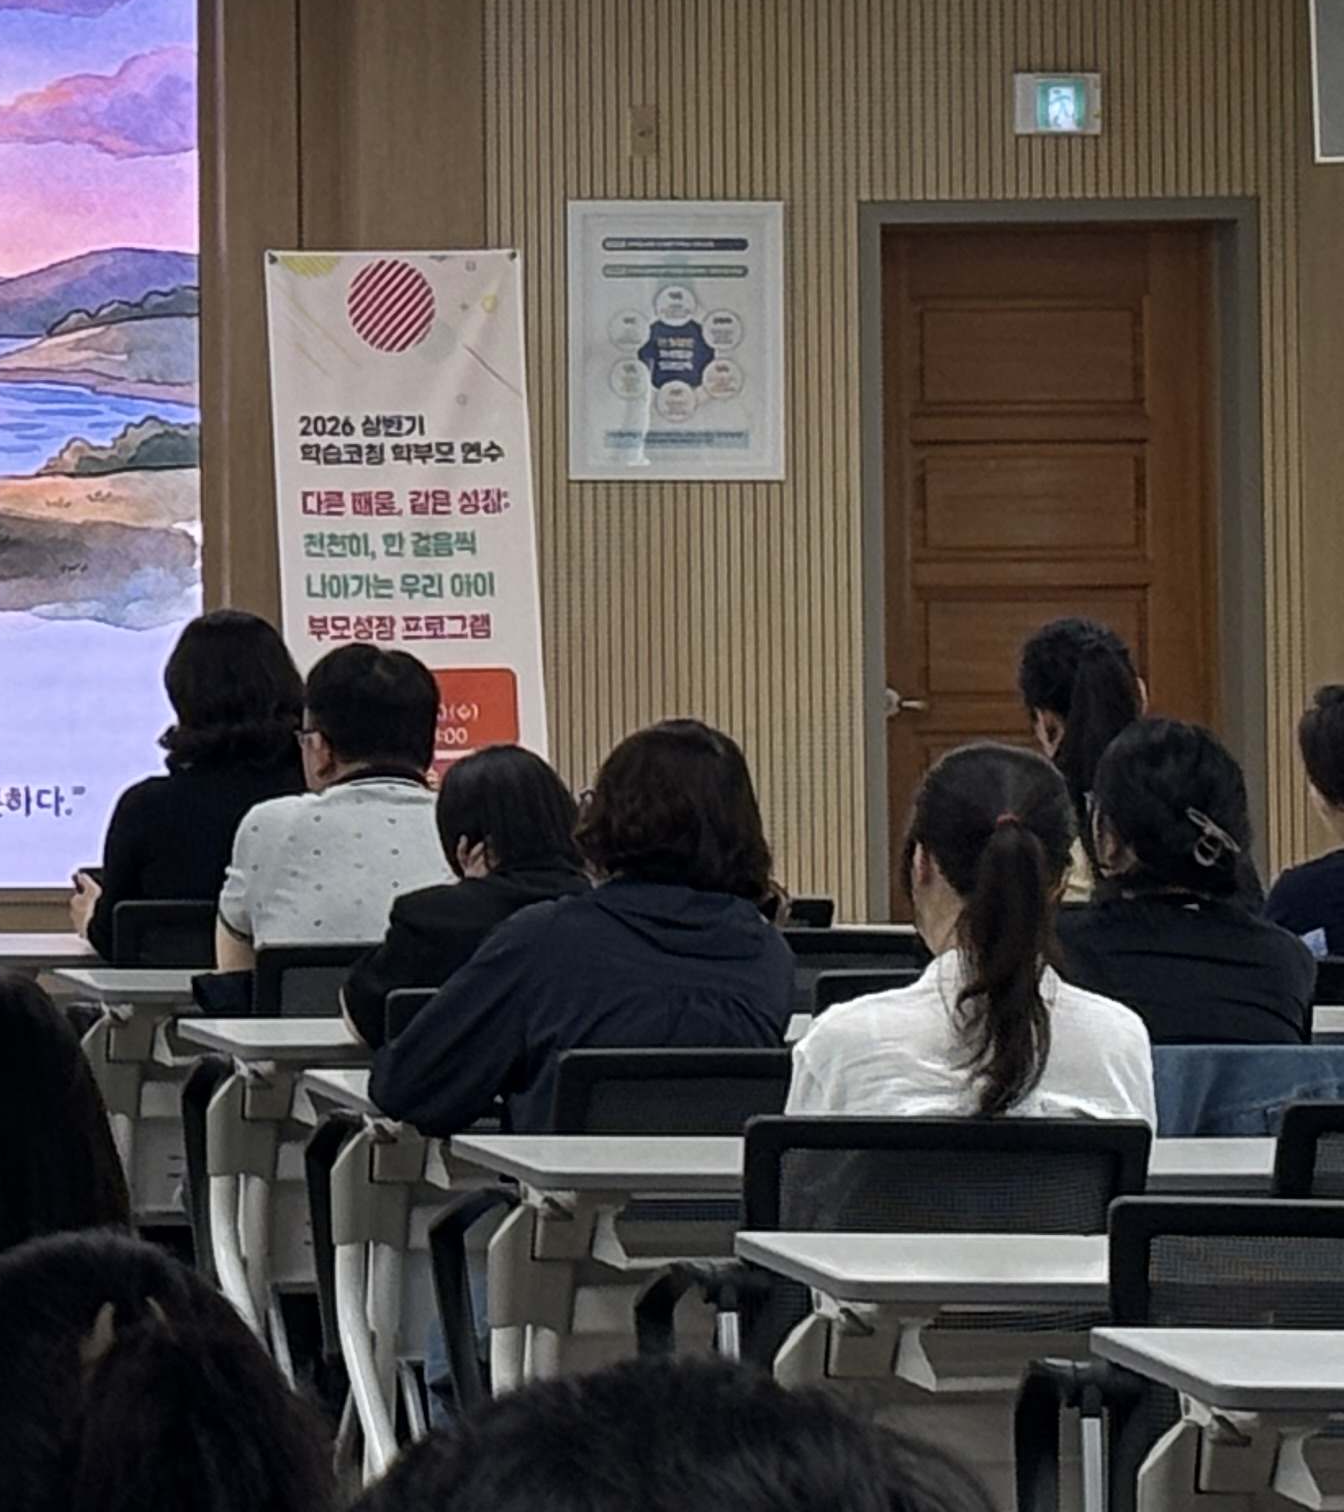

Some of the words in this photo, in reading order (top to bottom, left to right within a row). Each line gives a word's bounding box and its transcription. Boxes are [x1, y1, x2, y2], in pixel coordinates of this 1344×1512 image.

[298, 416, 354, 436] 2026
[362, 414, 424, 436] 상반기
[300, 442, 384, 464] 학습코칭
[392, 442, 456, 464] 학부모
[461, 441, 504, 464] 연수
[301, 491, 345, 516] 다른
[408, 490, 452, 515] 같은
[411, 531, 477, 557] 걸음씩
[306, 574, 394, 600] 나아가는
[400, 574, 444, 599] 우리
[451, 572, 496, 598] 아이
[308, 616, 396, 642] 부모성장
[402, 614, 492, 640] 프로그램
